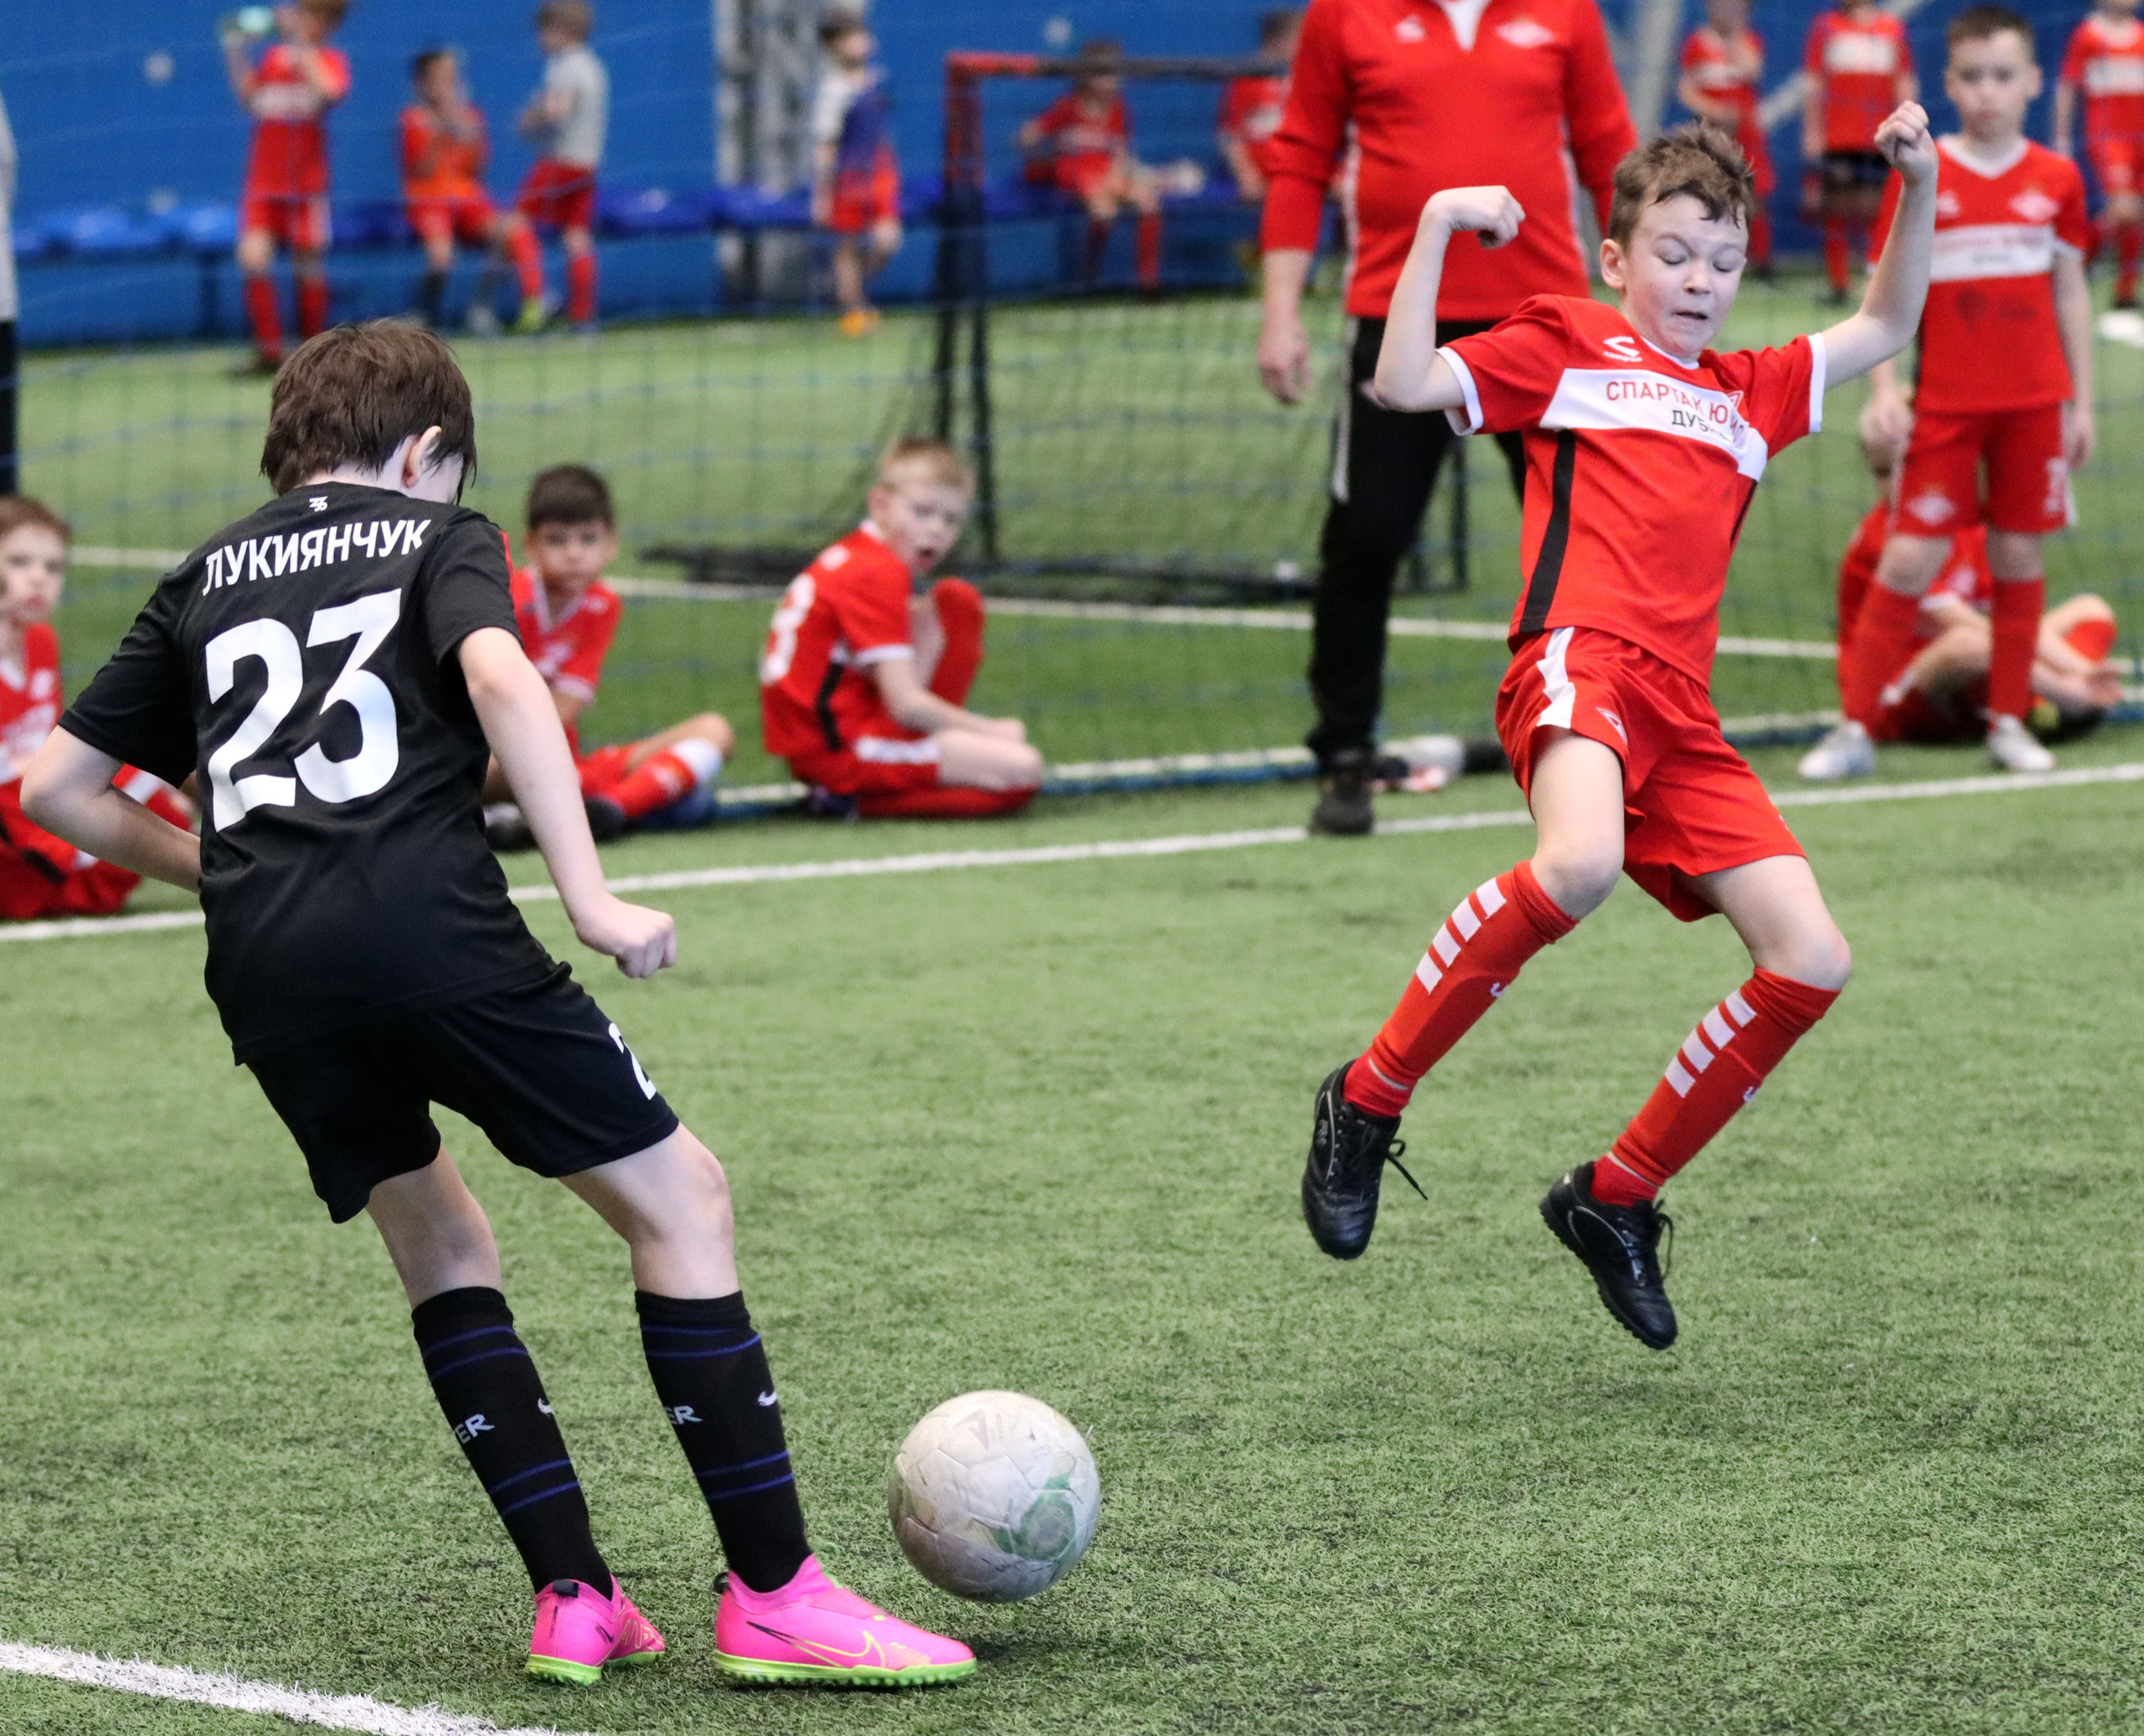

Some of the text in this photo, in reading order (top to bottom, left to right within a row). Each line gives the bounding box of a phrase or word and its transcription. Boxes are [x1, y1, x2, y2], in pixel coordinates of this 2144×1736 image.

[1606, 381, 1703, 415] СПАРТАК
[203, 519, 431, 596] ЛУКИЯНЧУК
[205, 588, 402, 833] 23
